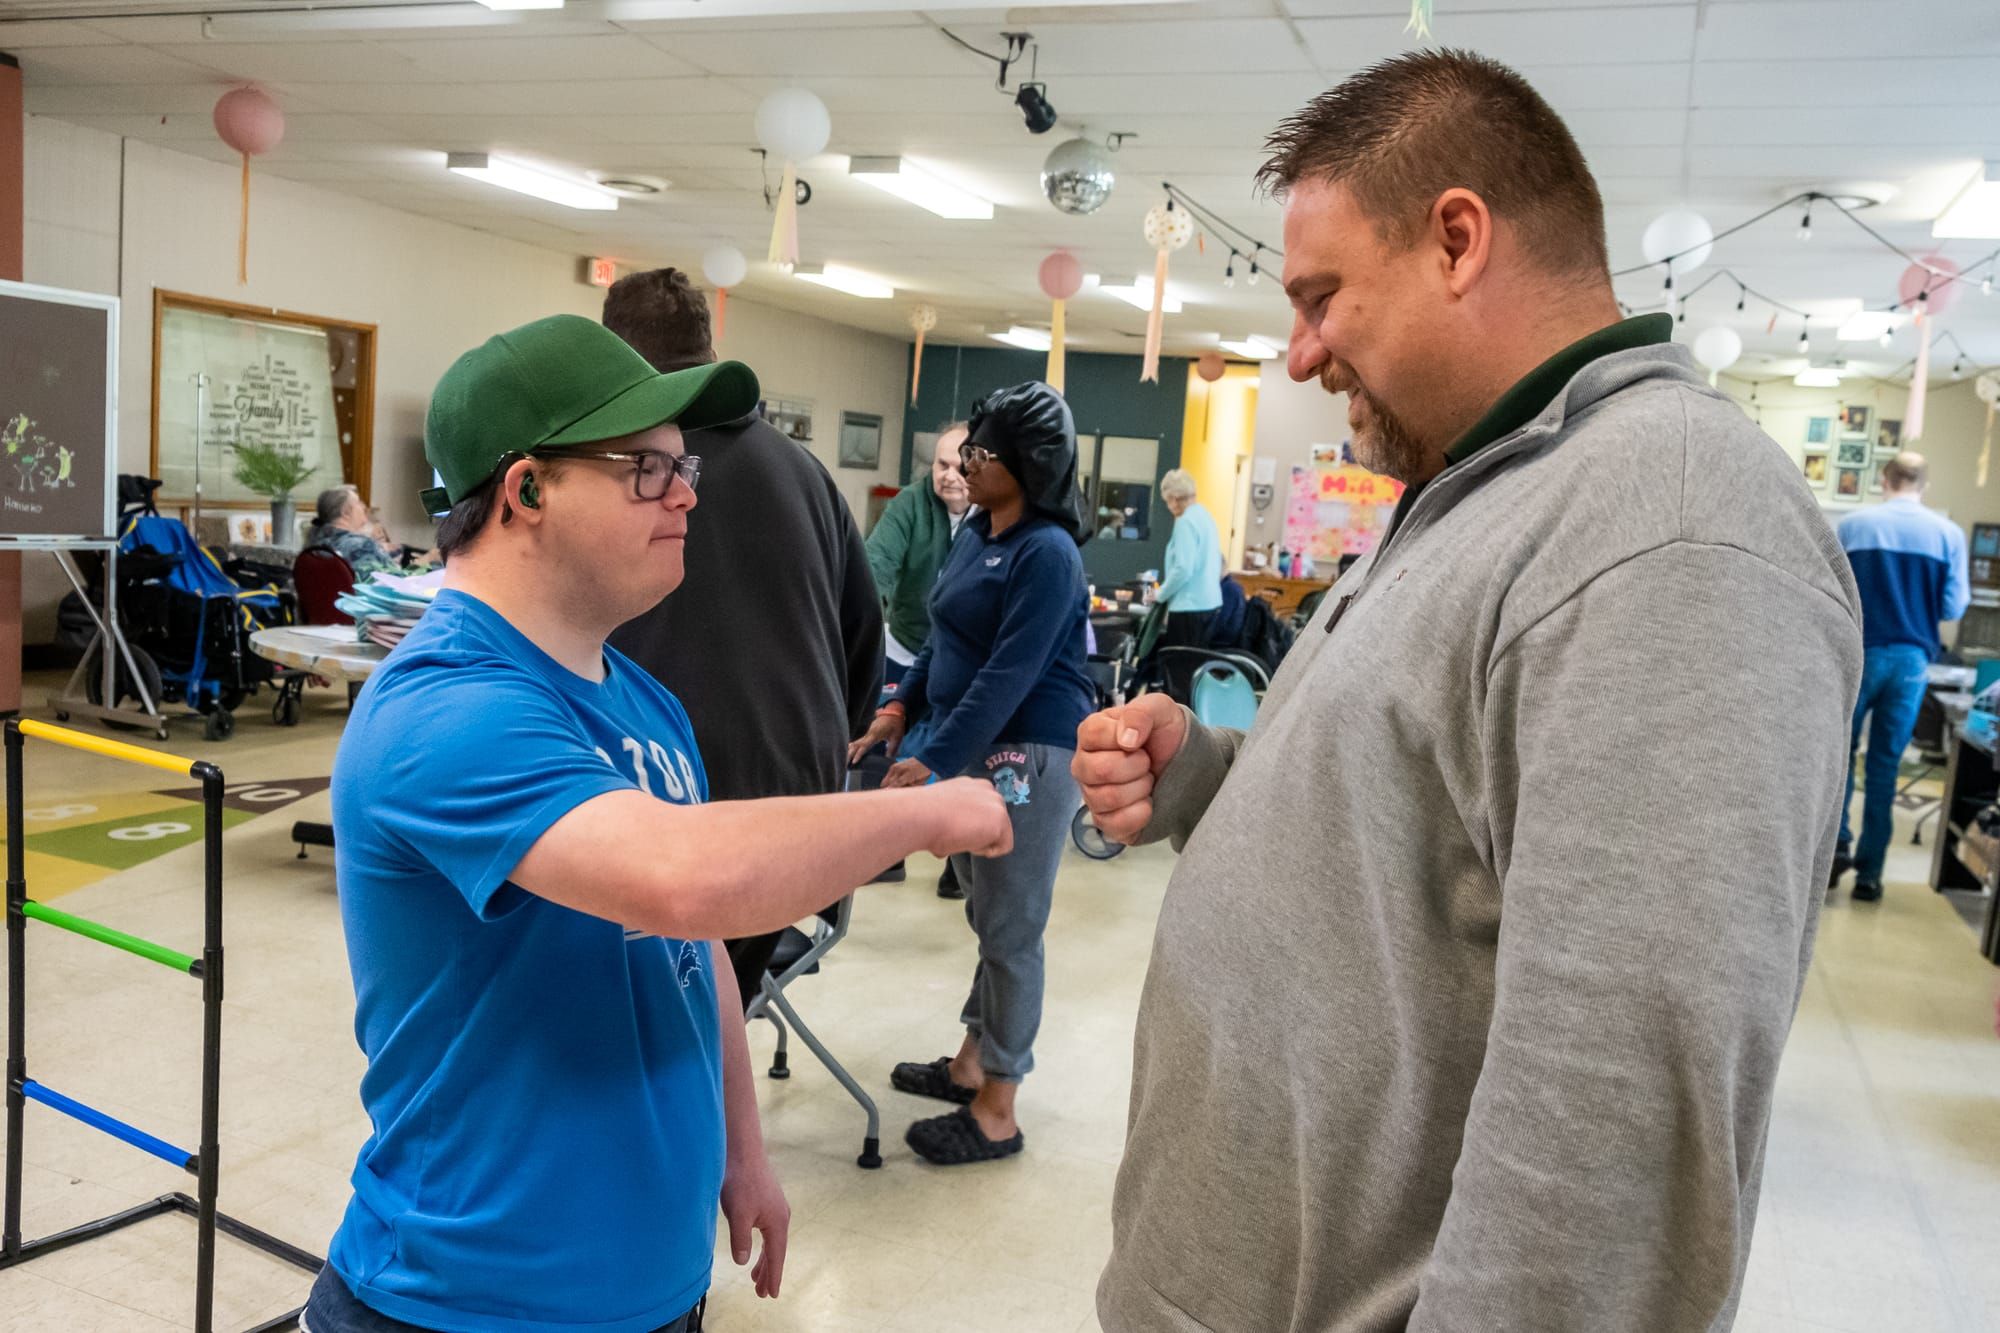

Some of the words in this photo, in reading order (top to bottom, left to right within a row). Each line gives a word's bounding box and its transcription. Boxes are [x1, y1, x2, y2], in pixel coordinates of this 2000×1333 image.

[234, 394, 284, 425] Family
[984, 751, 1027, 770] STITCH
[107, 821, 192, 841] 8
